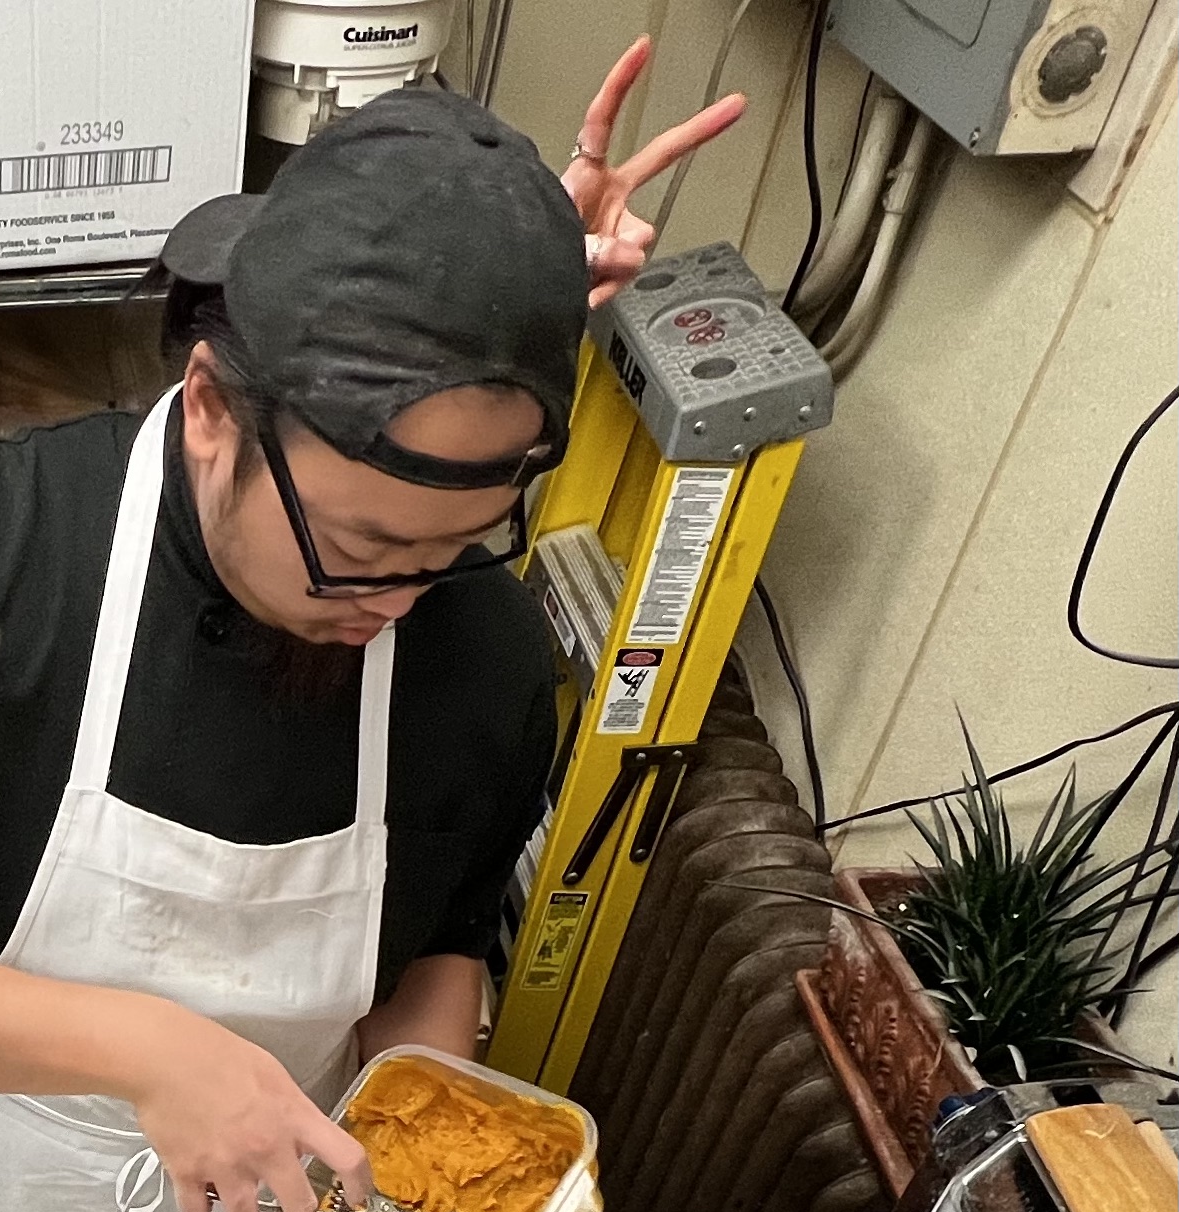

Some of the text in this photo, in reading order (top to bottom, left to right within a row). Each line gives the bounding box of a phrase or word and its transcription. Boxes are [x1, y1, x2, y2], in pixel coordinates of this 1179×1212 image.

[343, 24, 418, 43] Cuisinart
[60, 120, 124, 146] 233349
[10, 213, 69, 228] FOODSERVICE
[70, 211, 95, 223] SINCE
[27, 237, 42, 247] Inc.
[45, 235, 61, 245] One
